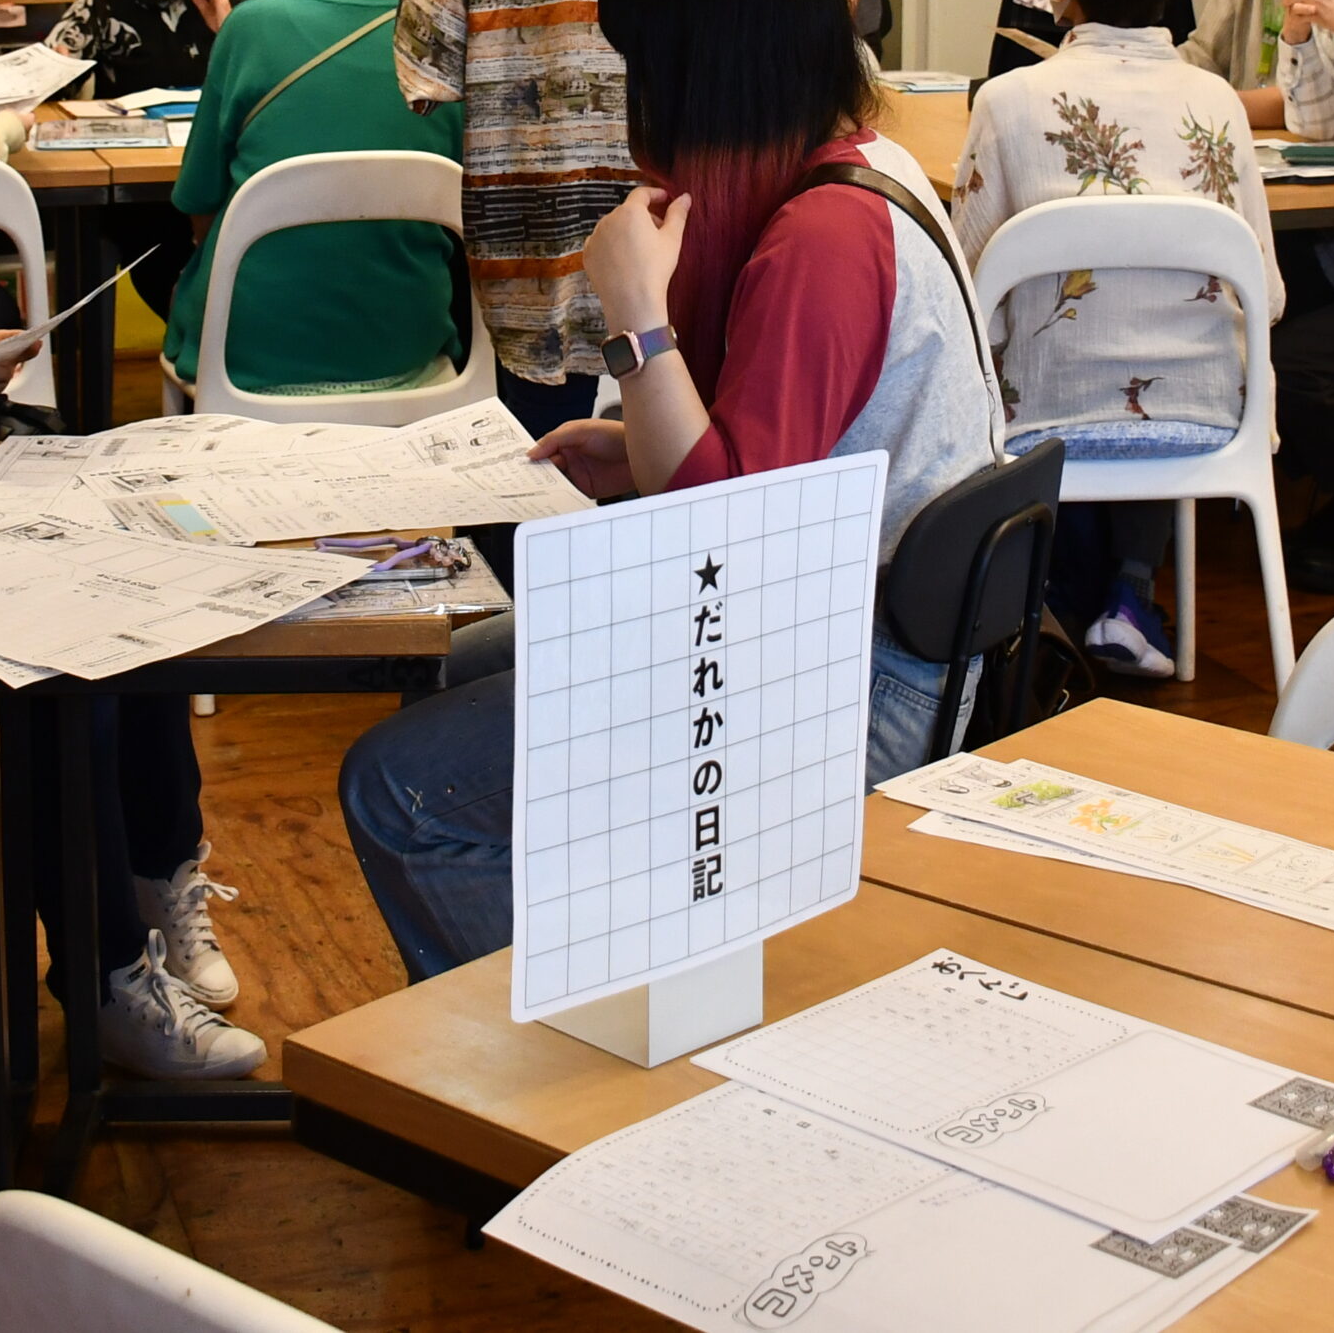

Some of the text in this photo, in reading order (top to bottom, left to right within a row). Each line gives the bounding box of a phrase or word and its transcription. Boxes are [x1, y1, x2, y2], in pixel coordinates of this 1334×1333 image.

[930, 956, 1029, 1001] おへんじ
[942, 1097, 1037, 1144] コメント
[752, 1240, 858, 1318] コメント
